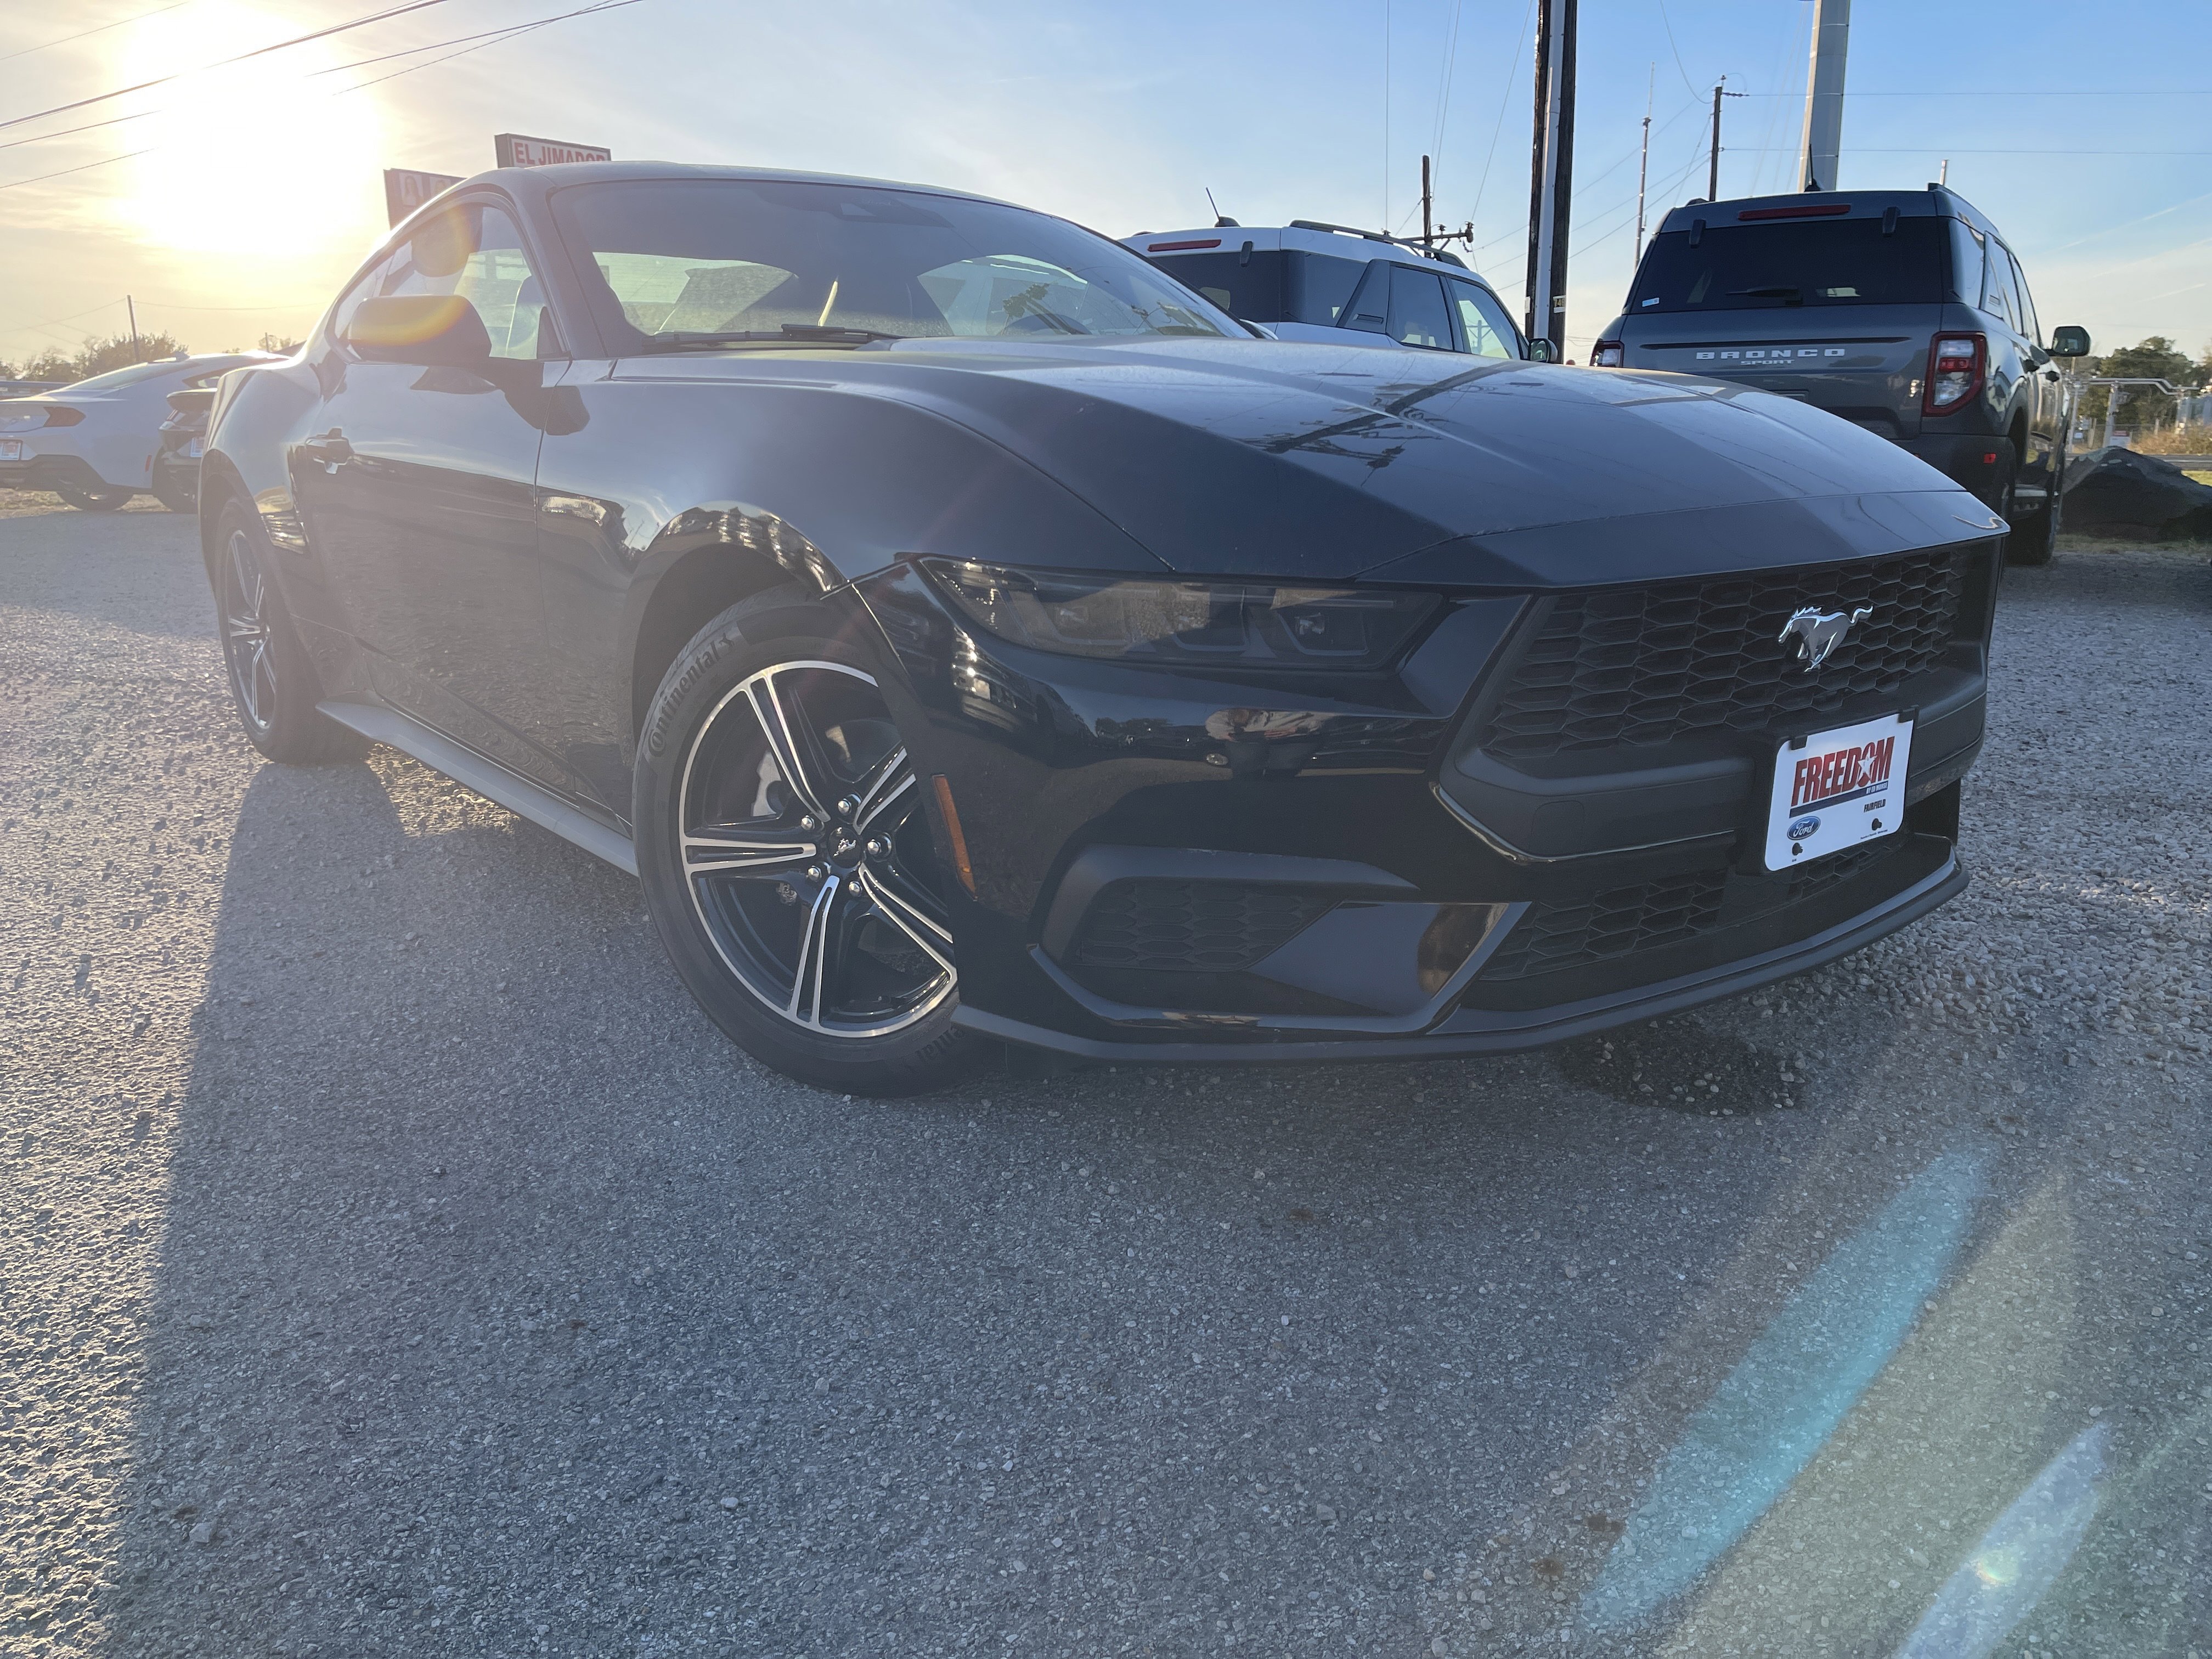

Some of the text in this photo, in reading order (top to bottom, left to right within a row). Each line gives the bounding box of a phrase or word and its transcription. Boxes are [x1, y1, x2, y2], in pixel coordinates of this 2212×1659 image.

[514, 142, 535, 165] EL
[1696, 348, 1845, 360] BRONCO
[648, 640, 720, 758] Continental
[1791, 736, 1895, 807] FREEDOM
[1793, 820, 1815, 837] Ford
